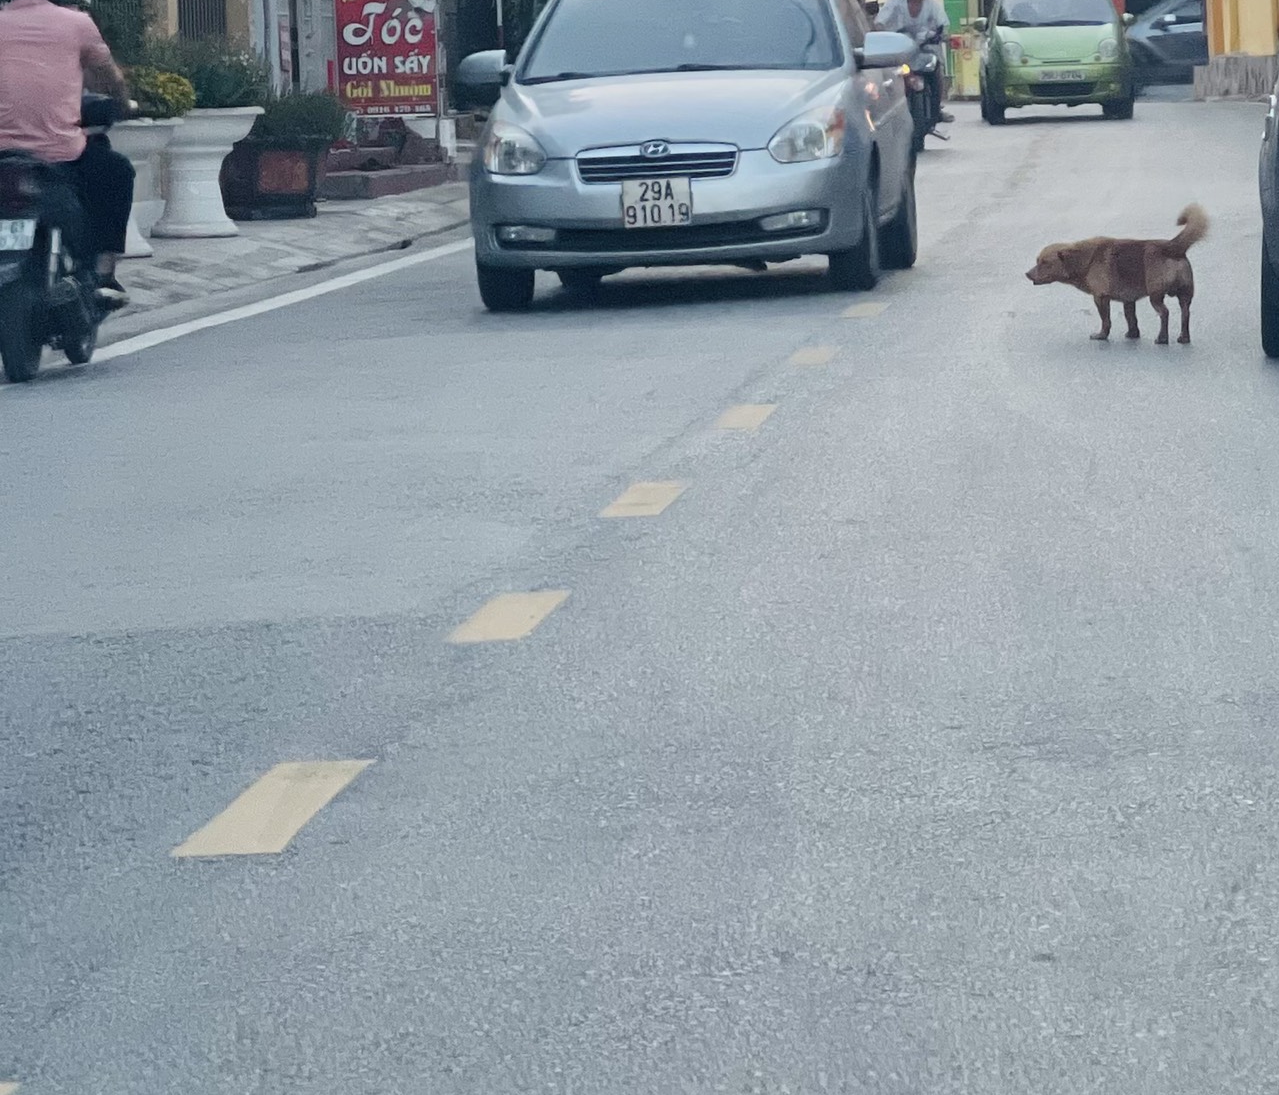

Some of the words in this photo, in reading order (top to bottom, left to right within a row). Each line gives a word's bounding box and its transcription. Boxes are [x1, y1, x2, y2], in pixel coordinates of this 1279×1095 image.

[343, 2, 424, 46] Tóc
[343, 50, 387, 75] UỐN
[394, 48, 431, 74] SẤY
[638, 179, 674, 203] 29A
